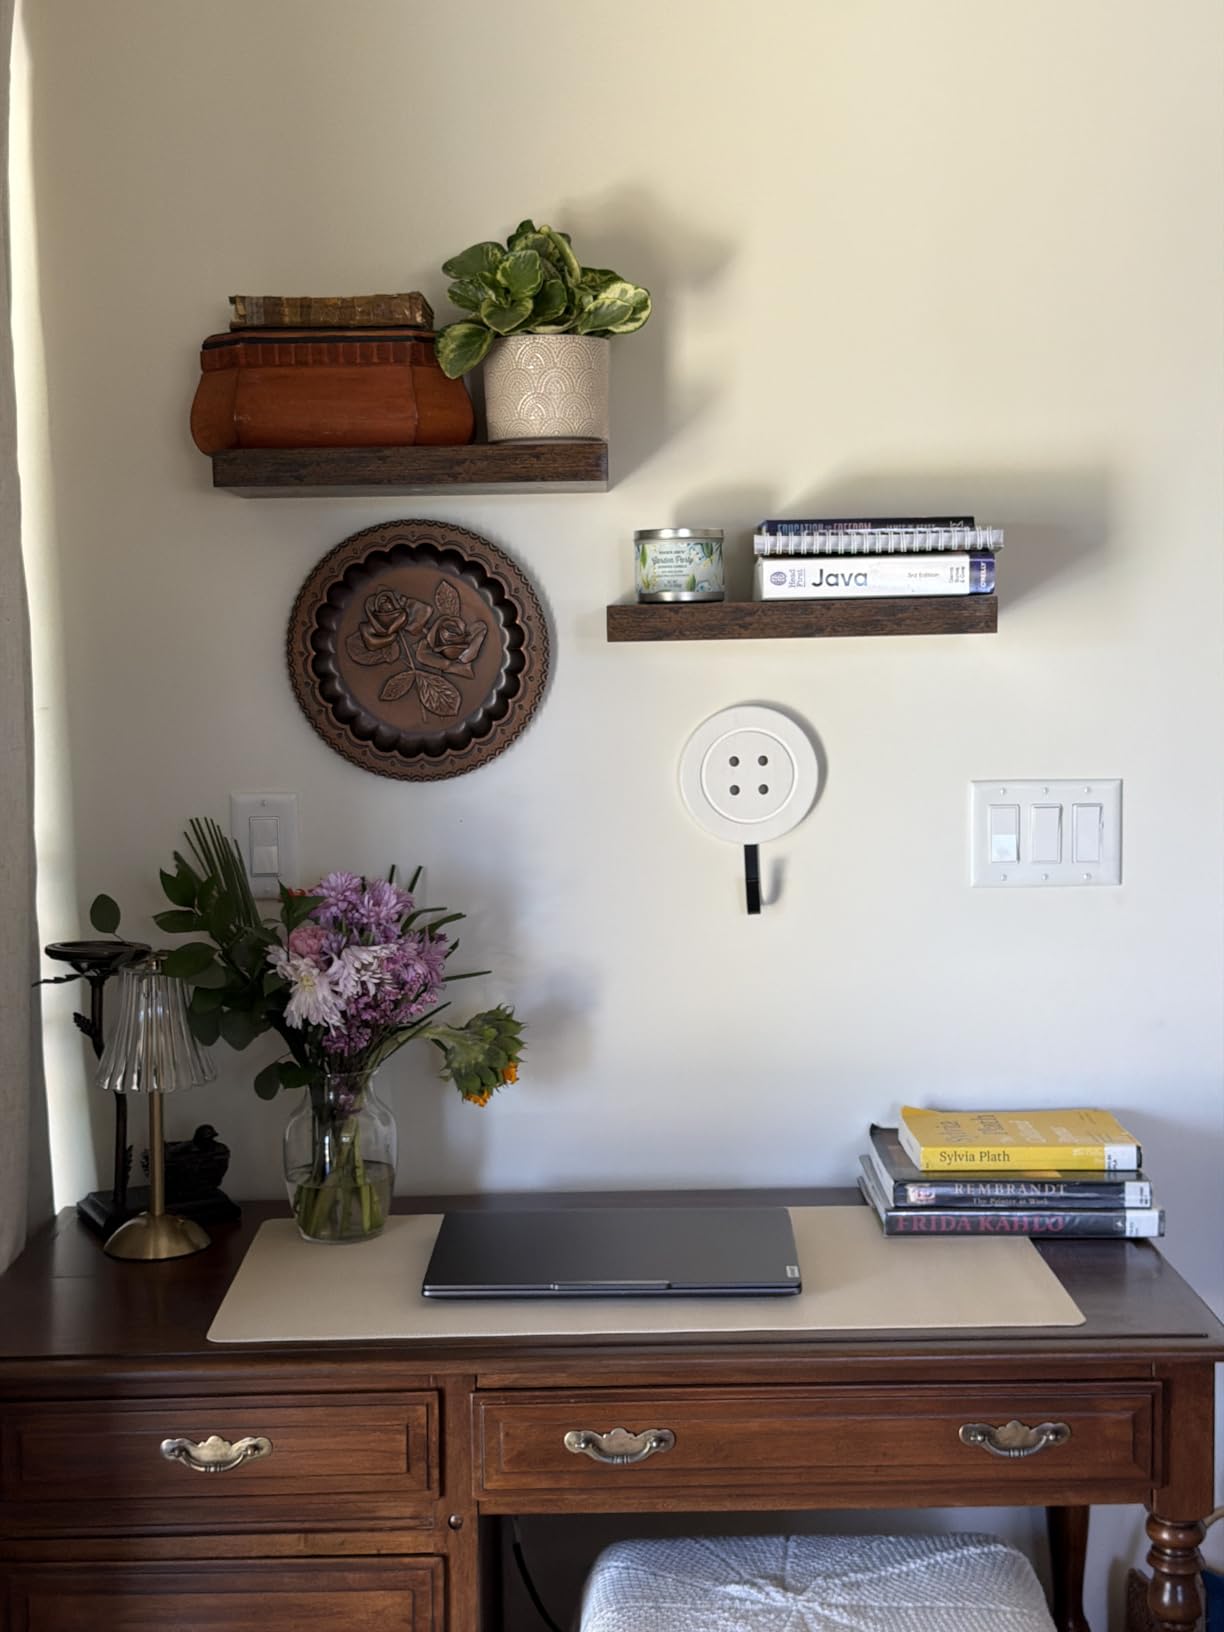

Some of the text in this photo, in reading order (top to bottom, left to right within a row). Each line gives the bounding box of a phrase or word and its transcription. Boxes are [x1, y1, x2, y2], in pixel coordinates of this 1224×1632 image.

[811, 568, 868, 588] Java
[939, 1149, 1010, 1164] Sylvia Plath
[953, 1183, 1067, 1196] REMBRANDT
[895, 1215, 1066, 1232] FRIDA KAHLO
